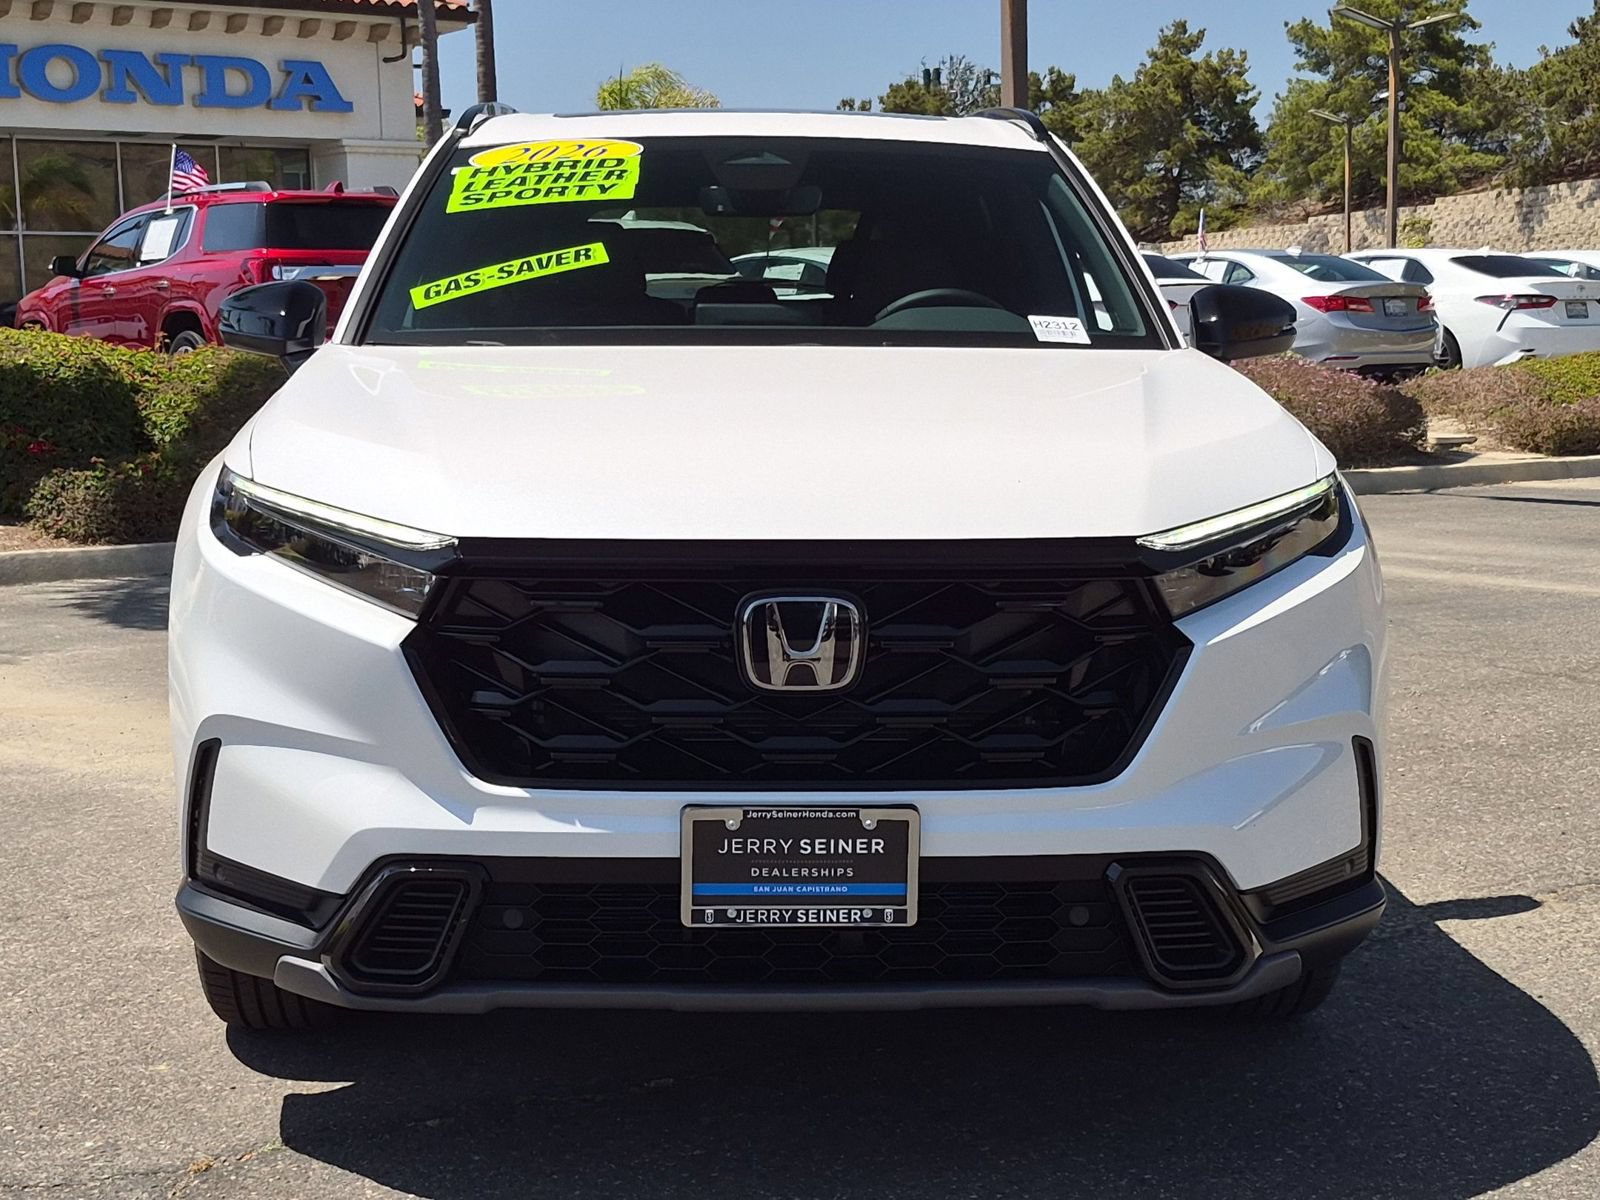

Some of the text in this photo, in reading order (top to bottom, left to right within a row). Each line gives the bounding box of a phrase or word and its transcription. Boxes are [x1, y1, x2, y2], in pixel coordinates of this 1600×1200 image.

[0, 43, 354, 113] ONDA
[502, 144, 616, 163] 2026
[469, 158, 625, 179] HYBRID
[461, 169, 628, 193] LEATHER
[460, 183, 618, 206] SPORTY
[423, 247, 593, 301] GAS-SAVER
[1033, 320, 1080, 330] H2312
[747, 810, 857, 820] JerrySeinerHonda.com
[718, 838, 885, 854] JERRY SEINER
[751, 867, 855, 877] DEALERSHIPS
[736, 909, 861, 923] JERRY SEINER
